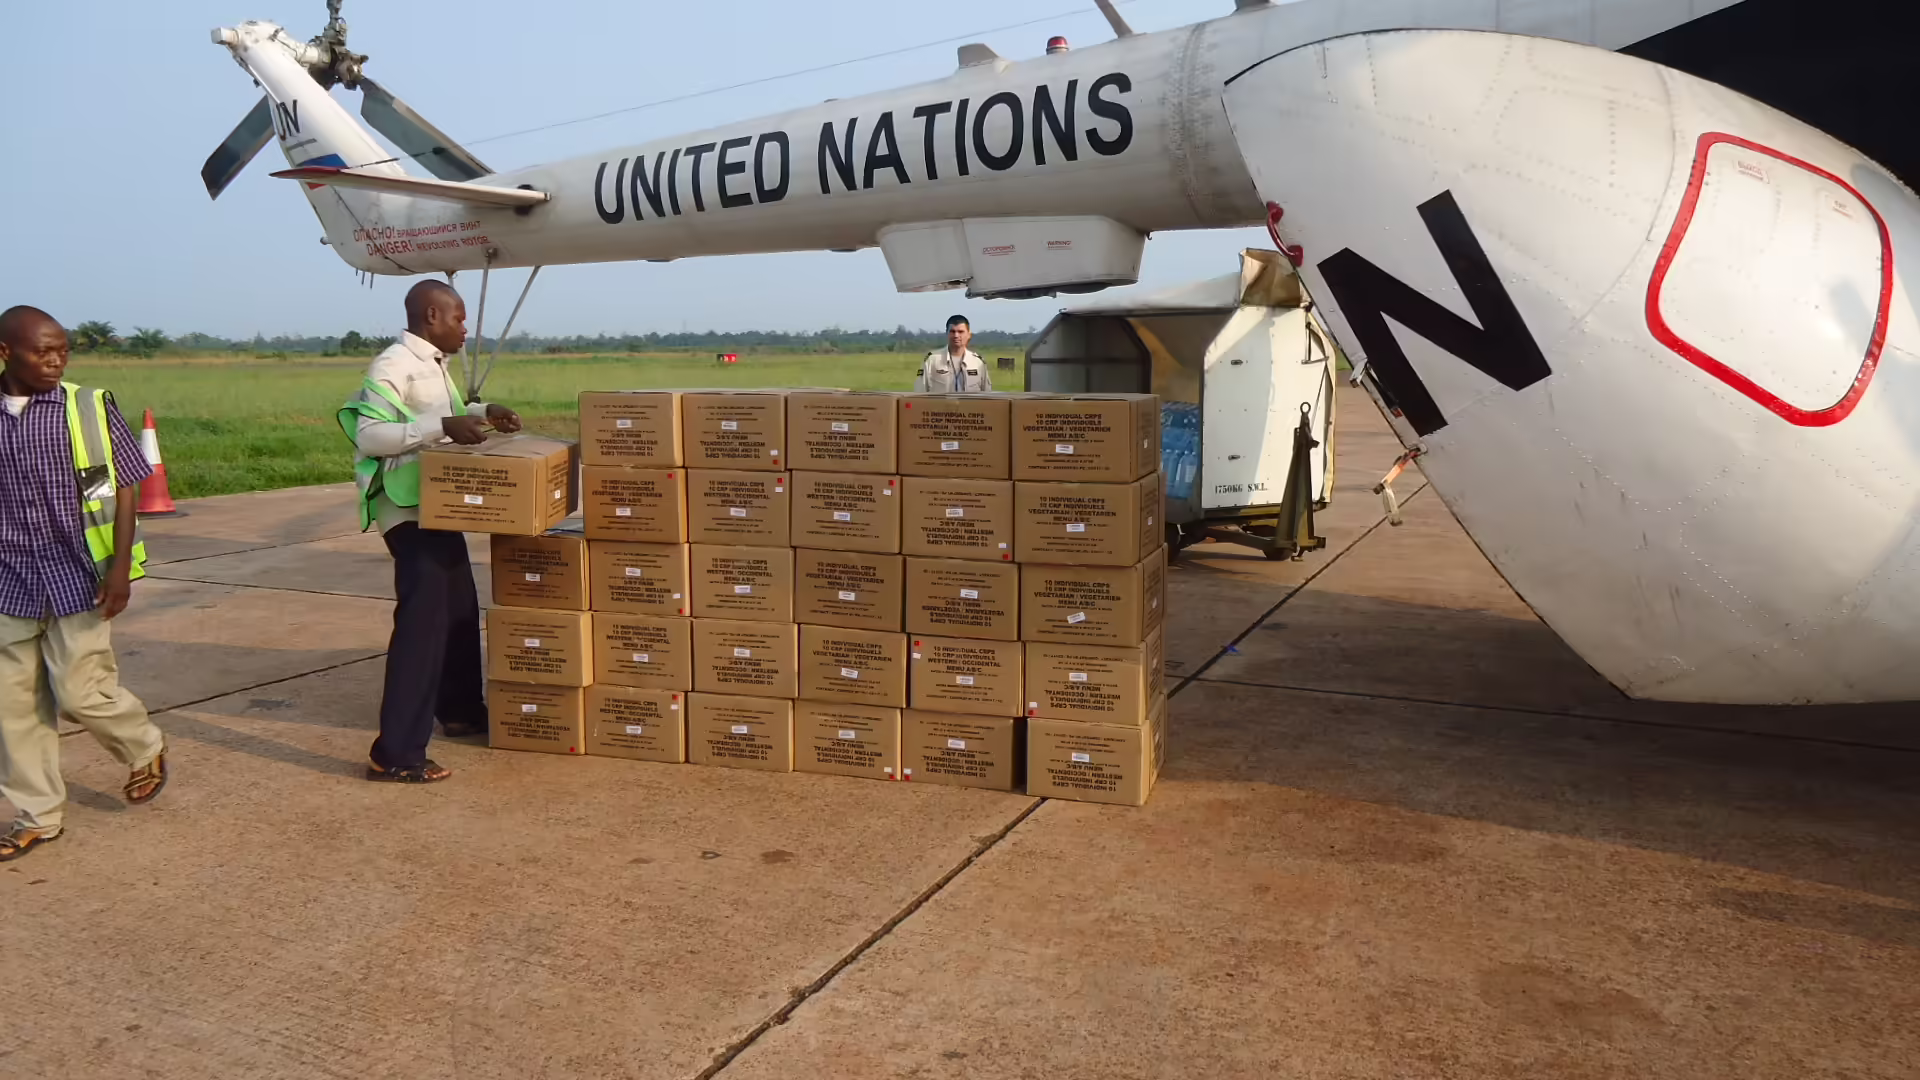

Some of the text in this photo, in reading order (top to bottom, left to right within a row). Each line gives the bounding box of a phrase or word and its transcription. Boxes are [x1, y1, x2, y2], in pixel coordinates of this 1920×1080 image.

[595, 72, 1133, 224] UNITED NATIONS
[460, 220, 481, 232] ВИНТ
[366, 239, 415, 256] DANGER!
[416, 239, 459, 251] REVOLVING
[1317, 189, 1552, 437] N
[1215, 484, 1243, 494] 1750KG
